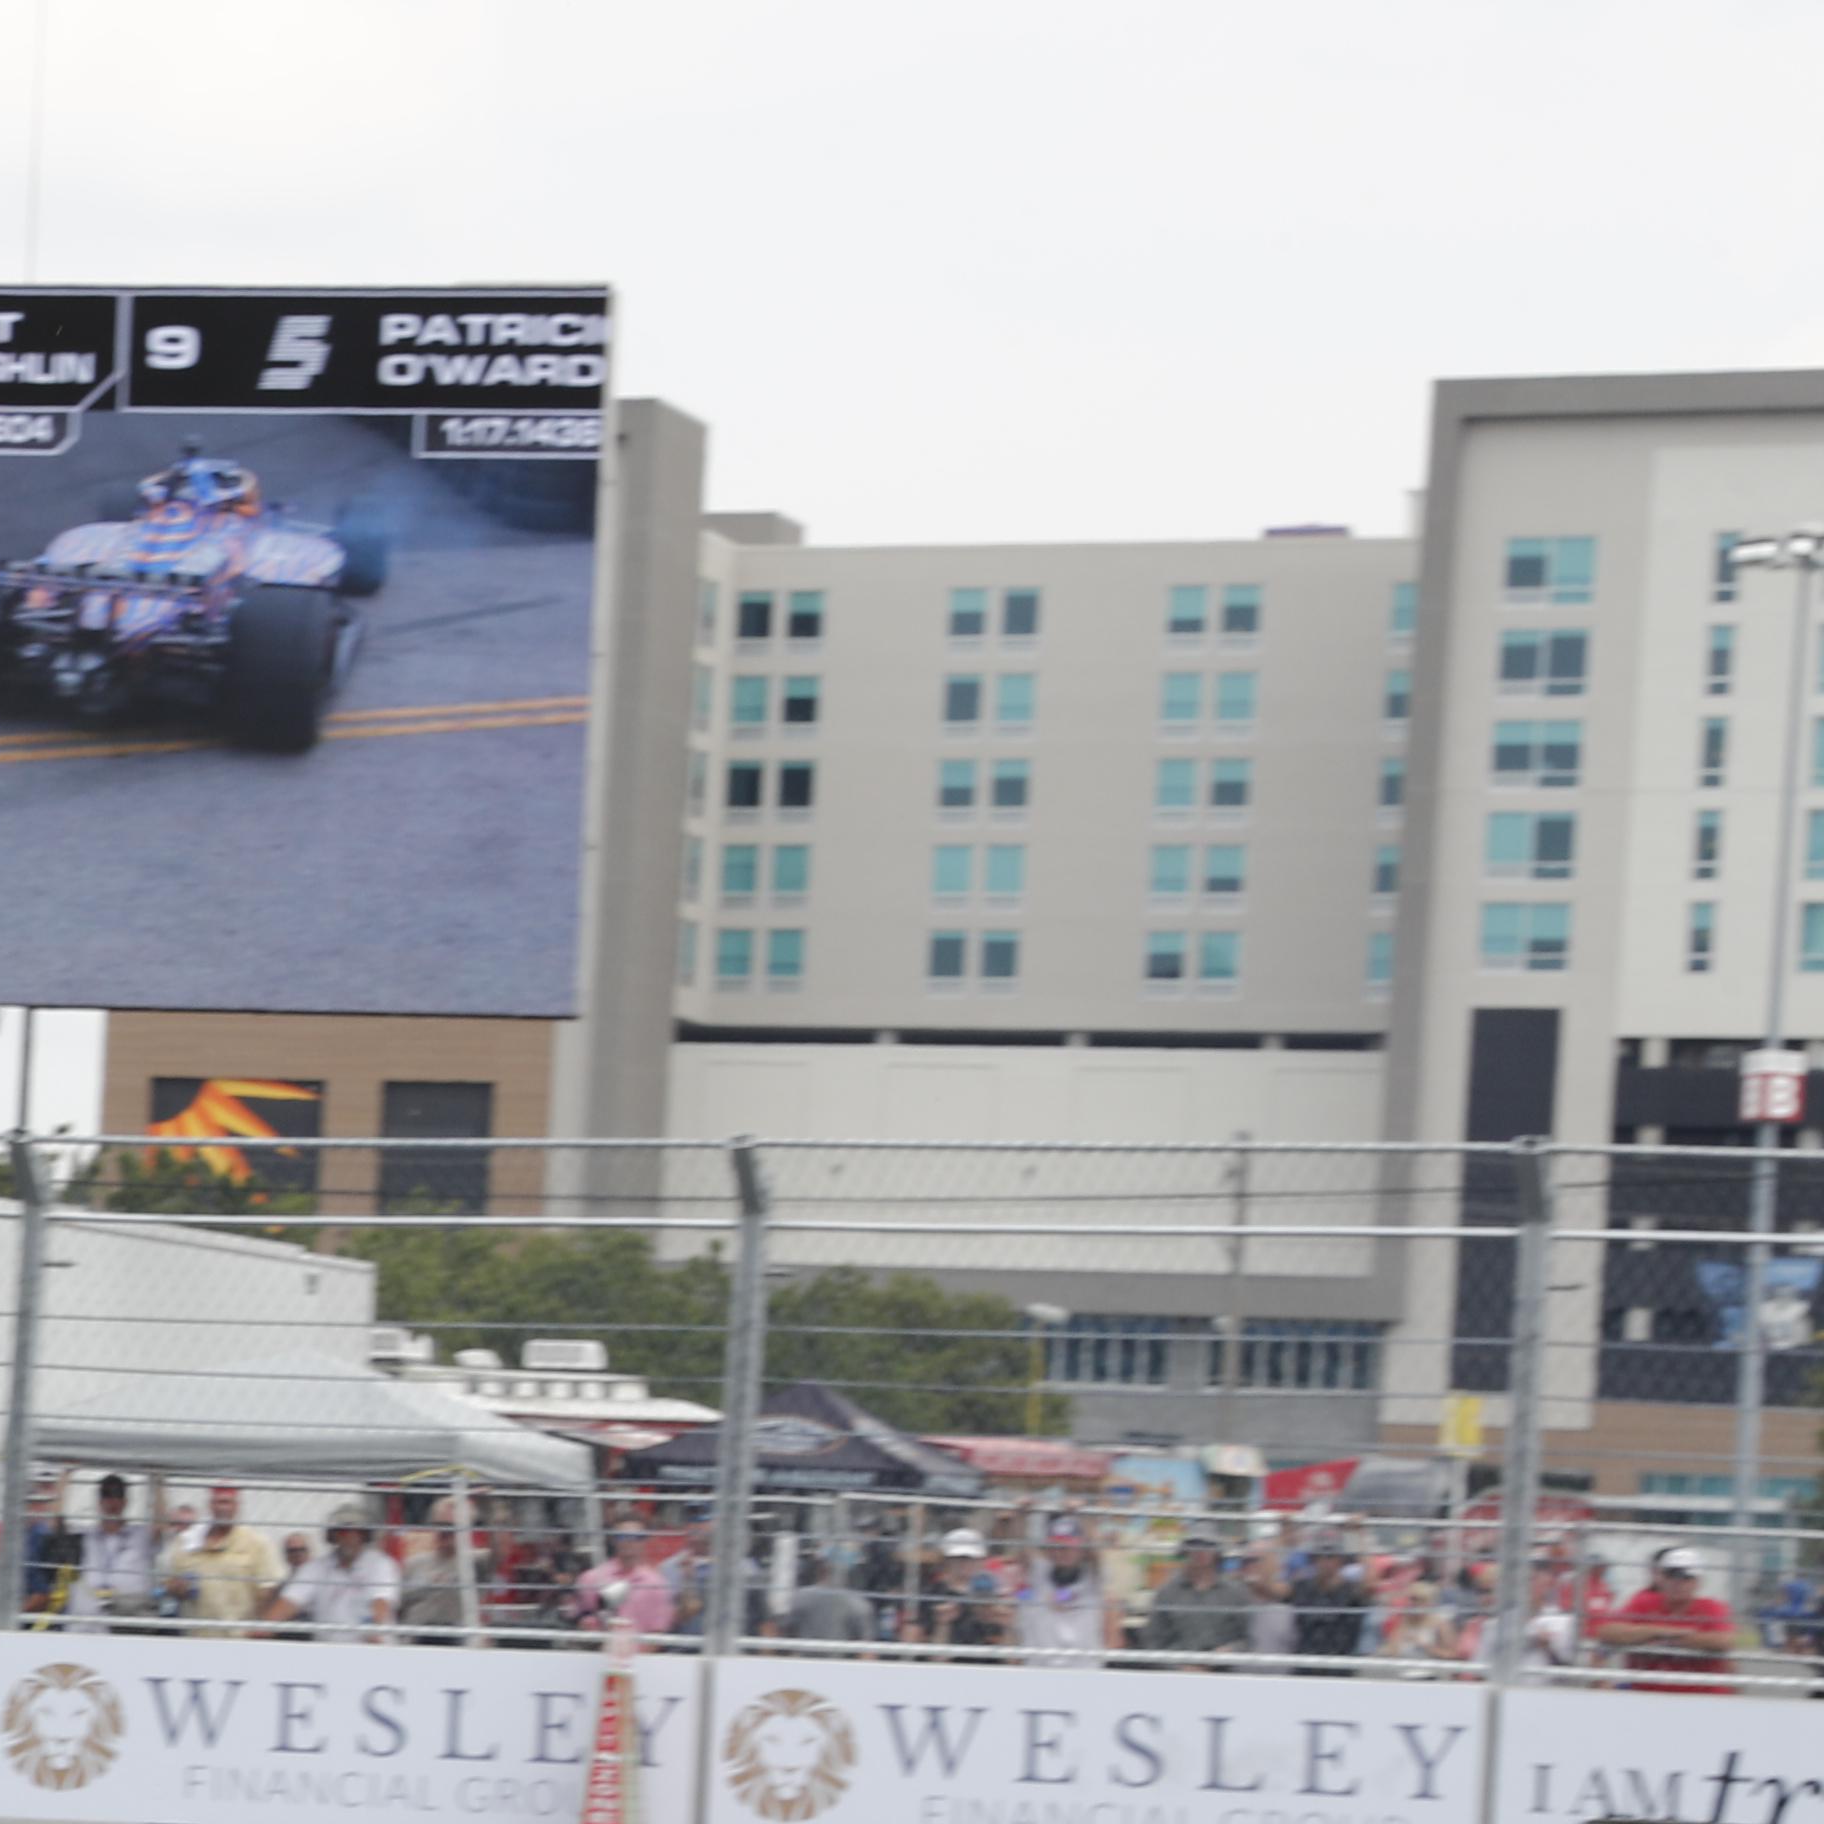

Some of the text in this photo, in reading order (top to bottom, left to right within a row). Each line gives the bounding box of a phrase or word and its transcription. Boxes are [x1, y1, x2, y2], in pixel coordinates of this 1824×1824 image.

[145, 326, 199, 368] 9
[257, 315, 332, 389] 5
[377, 353, 606, 387] O'WARD
[140, 1676, 685, 1769] WESLEY
[876, 1704, 1469, 1800] WESLEY
[182, 1764, 582, 1817] FINANCIAL GRO
[1569, 1766, 1687, 1821] AM
